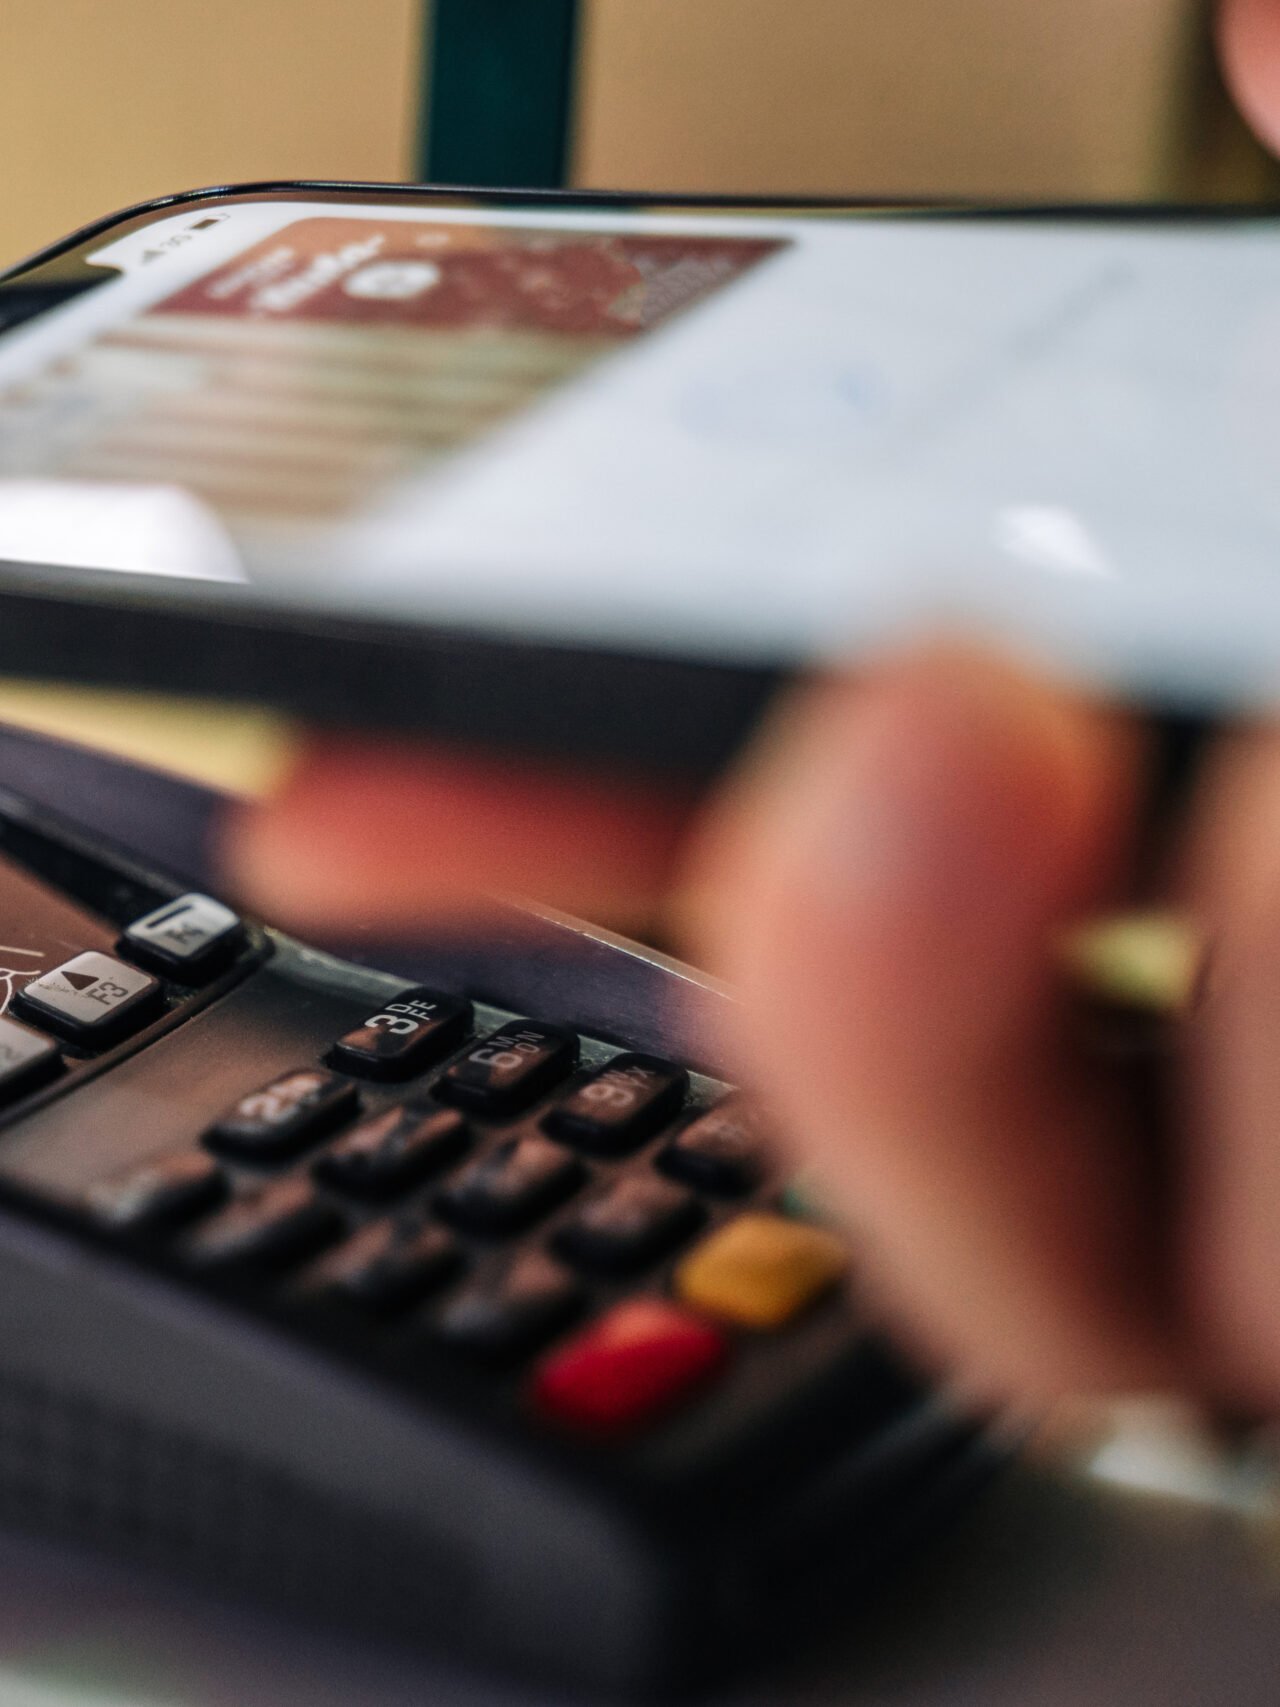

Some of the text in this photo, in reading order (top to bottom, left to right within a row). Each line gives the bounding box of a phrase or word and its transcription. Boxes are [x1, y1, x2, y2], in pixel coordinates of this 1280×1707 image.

[86, 982, 128, 1005] F3
[364, 1014, 419, 1035] 3
[468, 1048, 523, 1069] 6
[581, 1083, 634, 1108] 9
